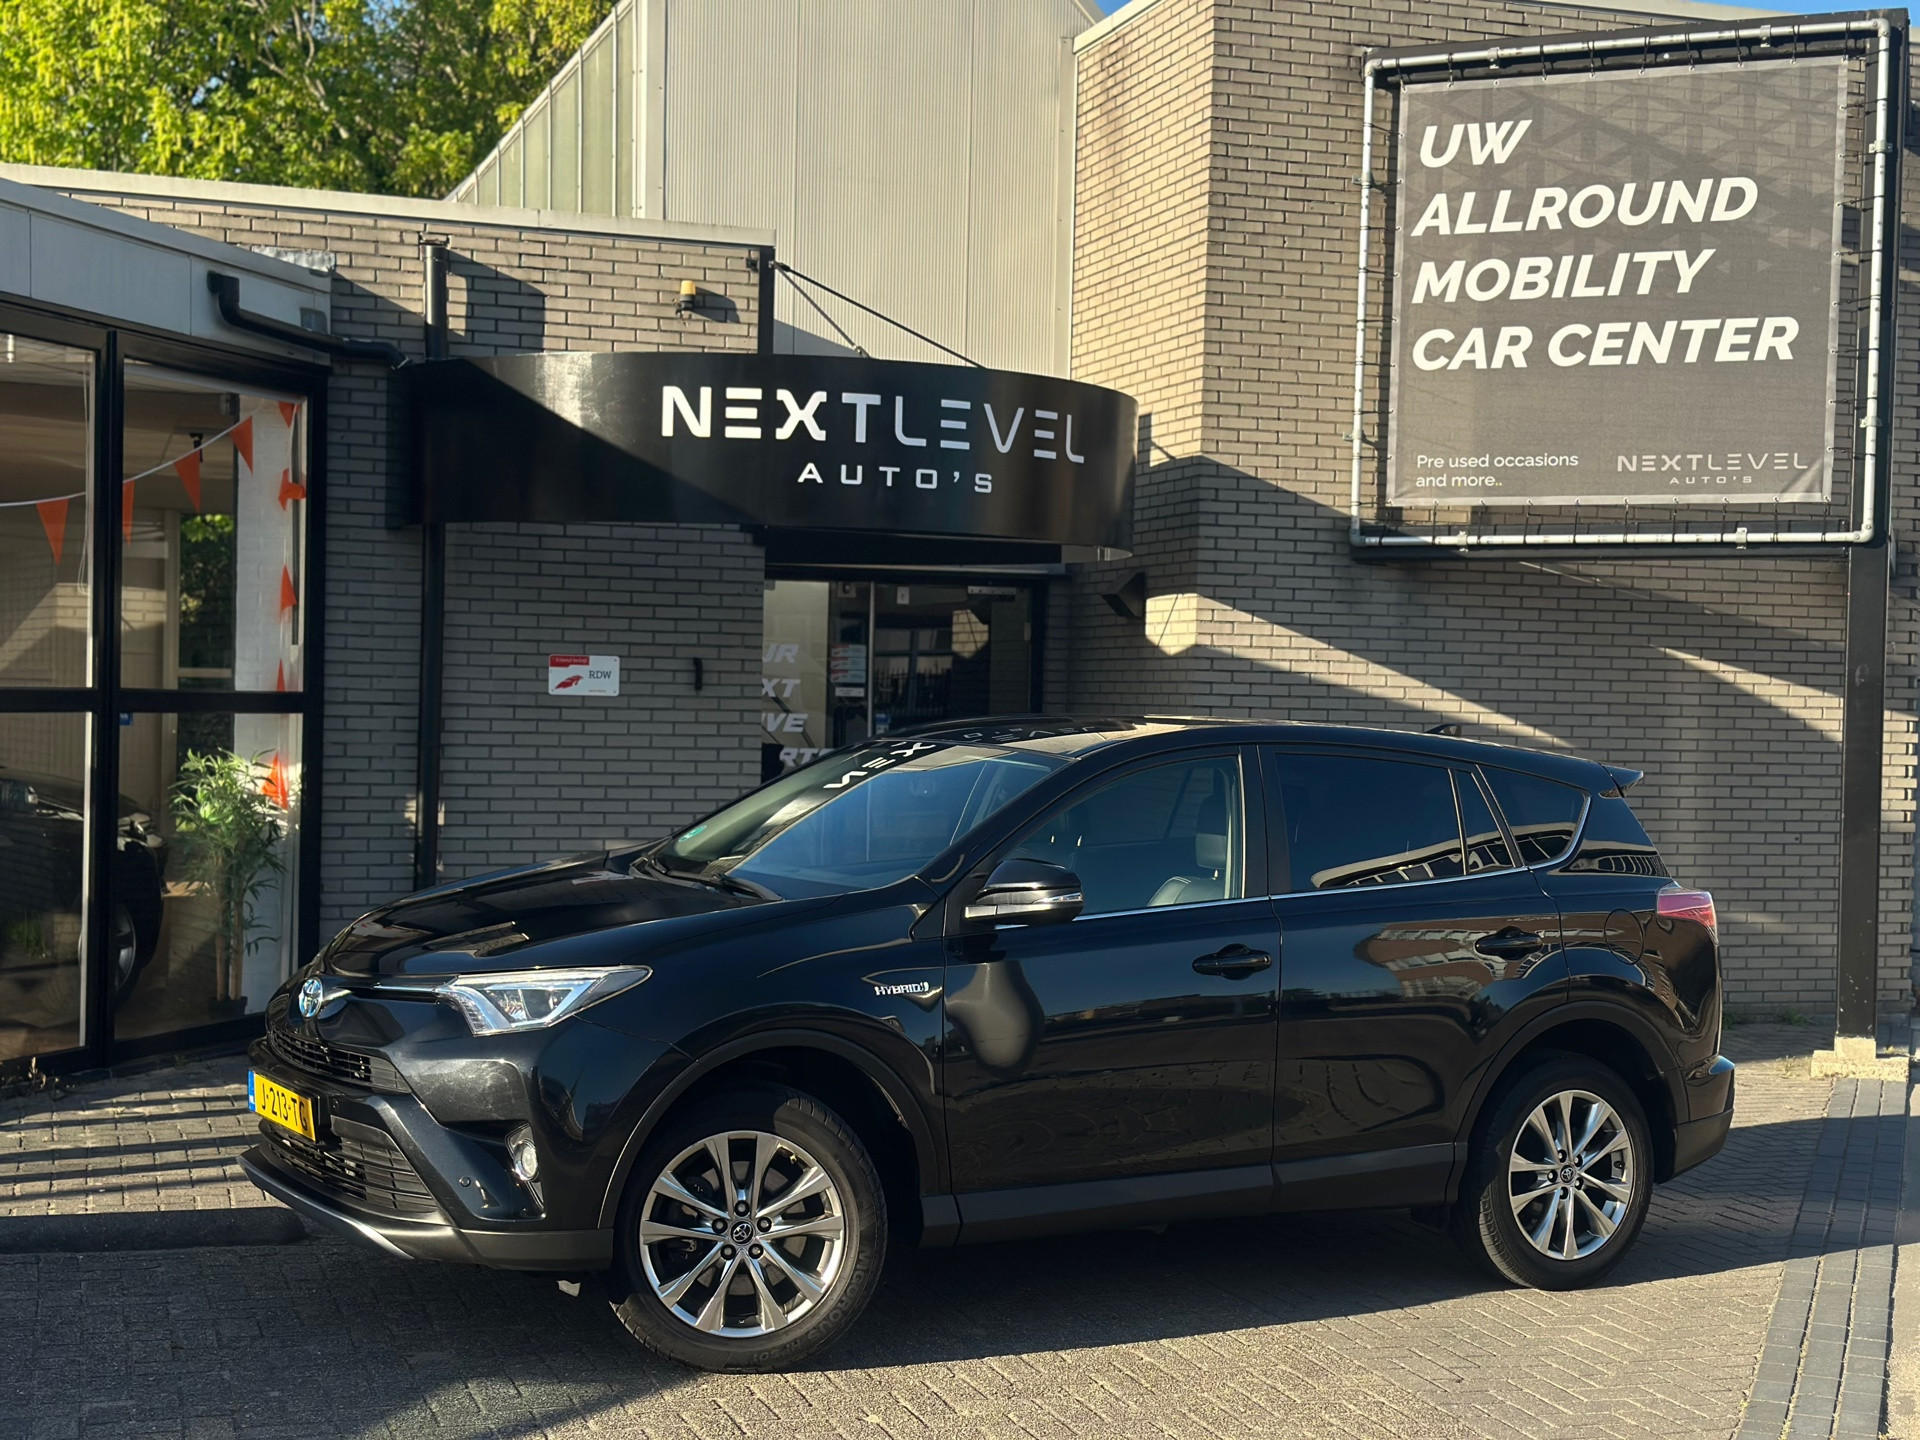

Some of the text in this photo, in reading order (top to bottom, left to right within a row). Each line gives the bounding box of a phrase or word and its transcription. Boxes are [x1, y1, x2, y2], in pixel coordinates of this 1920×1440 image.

[1419, 119, 1533, 168] UW
[1410, 176, 1758, 237] ALLROUND
[1411, 248, 1717, 304] MOBILITY
[1412, 315, 1800, 372] CAR CENTER
[661, 385, 1086, 464] NEXTLEVEL
[1416, 452, 1579, 468] Pre used occasions
[1616, 452, 1809, 472] NEXTLEVEL
[797, 462, 993, 494] AUTO'S
[1415, 473, 1503, 488] and more..
[1669, 475, 1752, 485] AUTO'S
[588, 670, 612, 680] RDW
[874, 983, 922, 996] HYBRID
